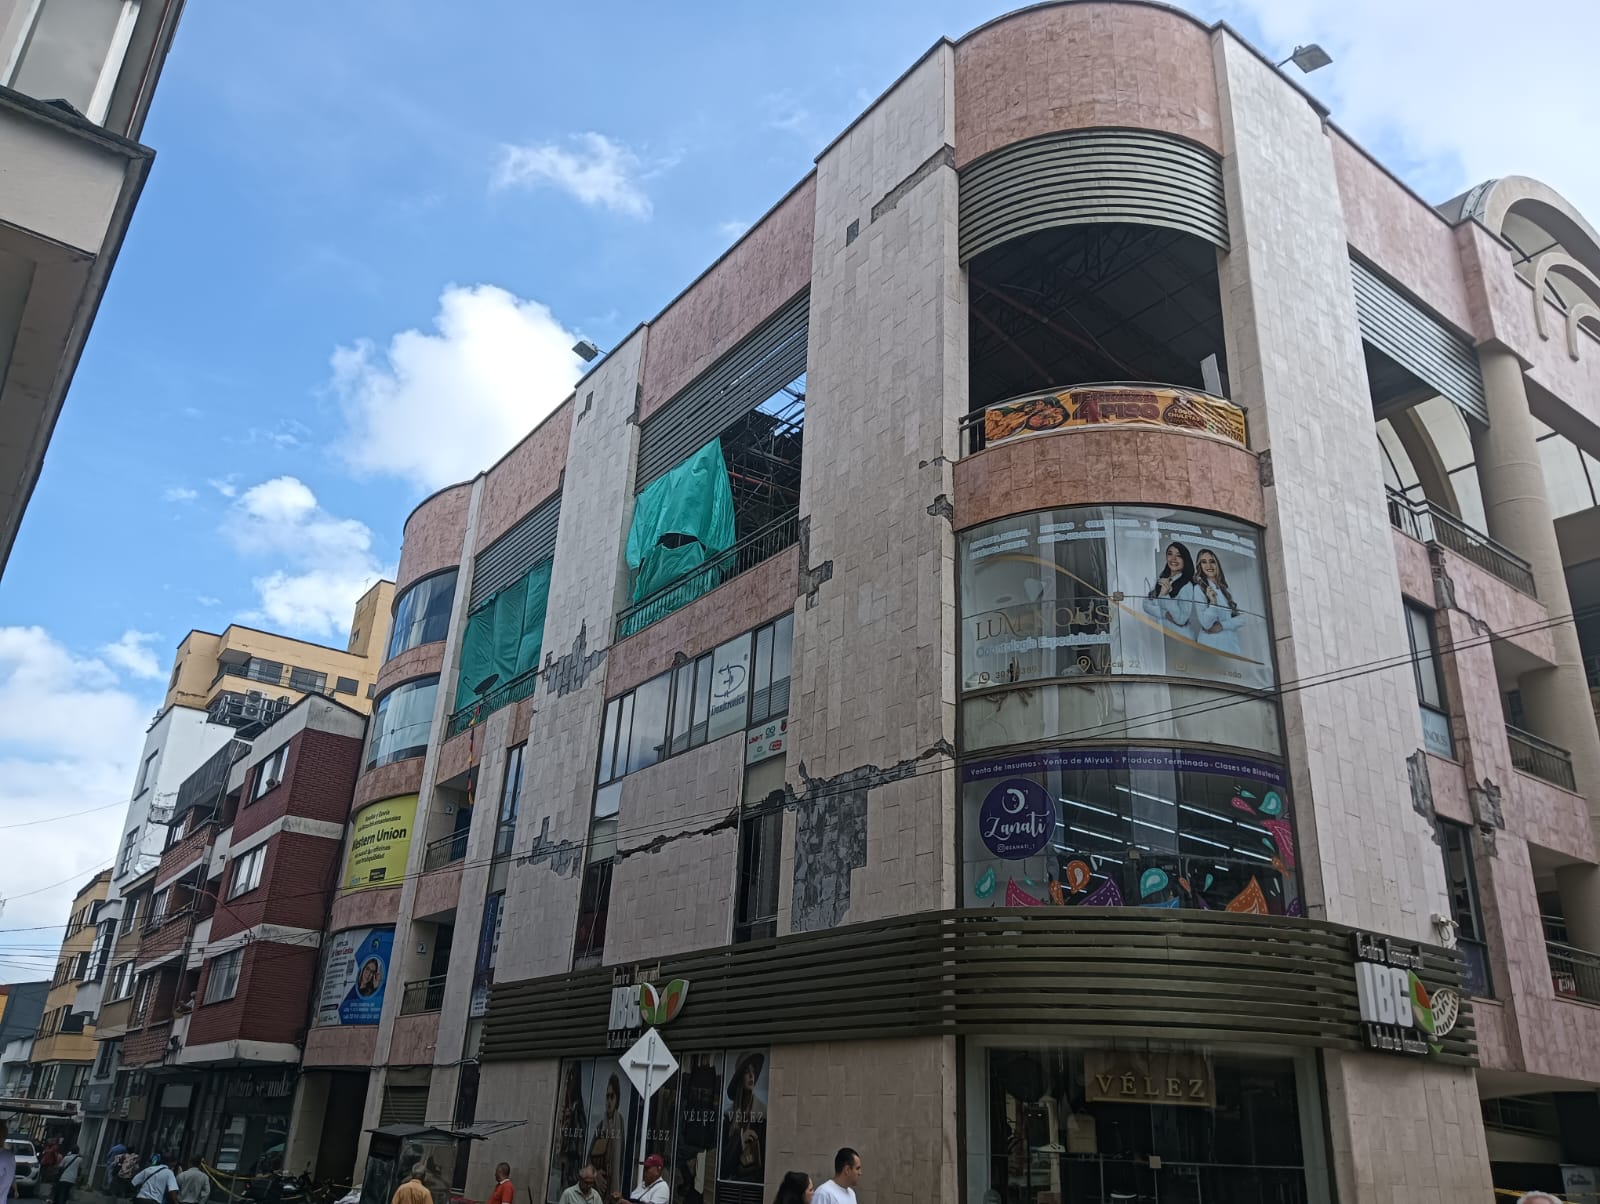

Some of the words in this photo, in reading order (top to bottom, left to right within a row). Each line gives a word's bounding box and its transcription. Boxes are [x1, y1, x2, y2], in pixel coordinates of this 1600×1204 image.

[970, 766, 992, 776] Venta
[993, 764, 1004, 773] de
[1042, 758, 1068, 766] Venta
[1070, 757, 1082, 765] de
[1084, 756, 1113, 766] Miyuki
[1121, 756, 1162, 765] Producto
[1164, 757, 1208, 768] Terminado
[1214, 761, 1240, 772] Clases
[1241, 765, 1251, 774] de
[376, 827, 407, 842] Union
[984, 810, 1050, 841] Zanati
[1355, 961, 1413, 1028] IBG
[1096, 1072, 1205, 1098] VÉLEZ
